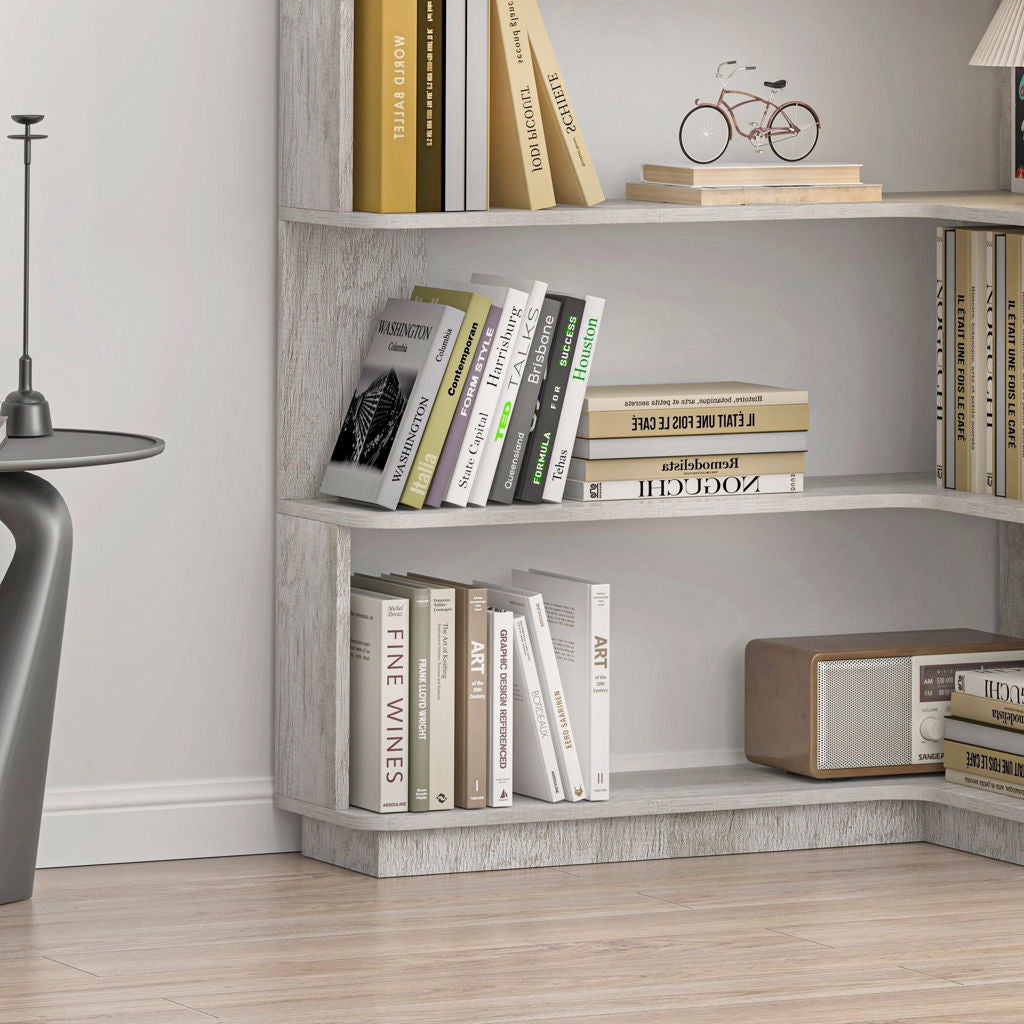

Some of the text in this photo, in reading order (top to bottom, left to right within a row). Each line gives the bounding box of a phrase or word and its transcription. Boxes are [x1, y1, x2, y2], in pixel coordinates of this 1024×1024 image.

[377, 319, 433, 340] WASHINGTON
[387, 341, 409, 353] Columbia
[458, 305, 523, 489] State Capital Harrisburg
[460, 326, 495, 417] FORM STYLE
[493, 306, 539, 442] TED TALKS
[957, 294, 965, 442] IL ÉTAIT UNE FOIS LE CAFÉ
[391, 328, 453, 483] WASHINGTON Columbia
[409, 322, 479, 496] Italia Contemporan
[504, 315, 554, 490] Queensland Brisbane
[532, 315, 578, 486] FORMULA FOR SUCCESS
[552, 317, 599, 482] Tehas Houston
[386, 629, 404, 783] FINE WINES
[418, 658, 427, 740] FRANK LLOYD WRIGHT
[470, 640, 485, 675] ART
[499, 629, 508, 769] GRAPHIC DESIGN REFERENCED
[531, 690, 549, 739] BORDEAUX
[553, 690, 573, 749] EERO SAARINEN
[594, 635, 608, 669] ART
